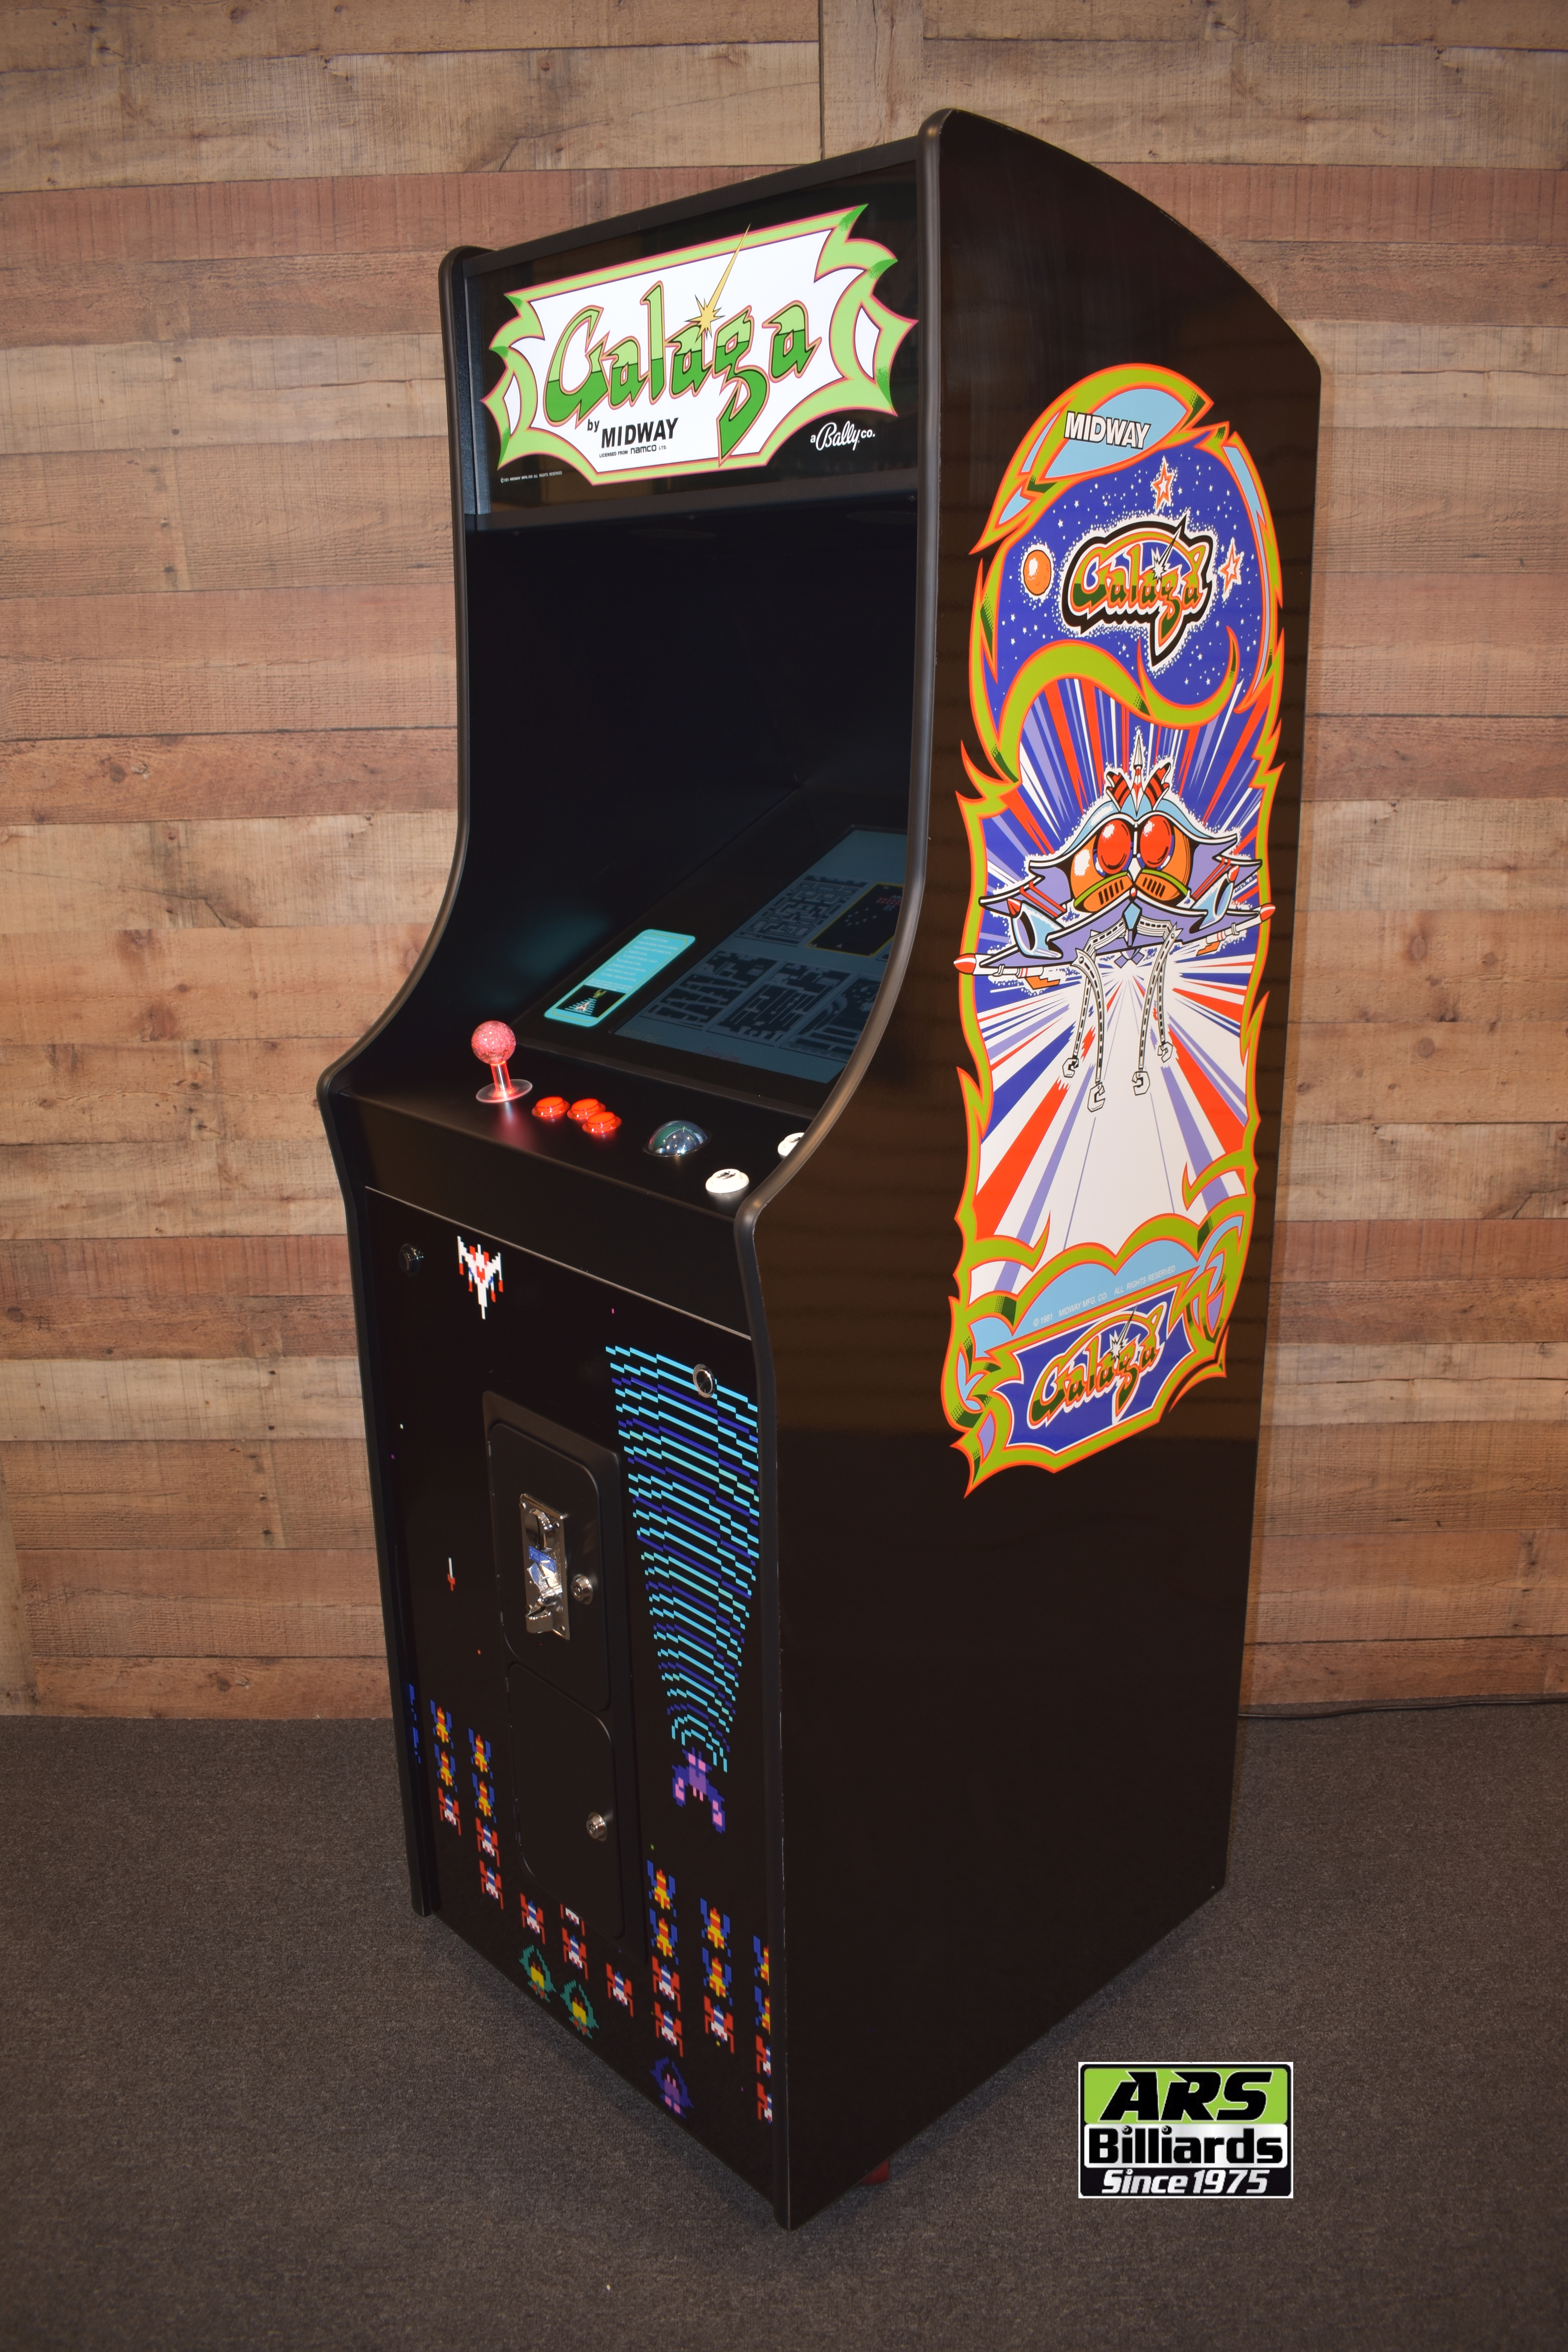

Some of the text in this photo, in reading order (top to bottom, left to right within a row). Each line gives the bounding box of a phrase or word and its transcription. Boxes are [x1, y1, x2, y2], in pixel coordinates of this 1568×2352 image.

[544, 280, 821, 467] Galaga
[587, 419, 600, 433] by
[601, 417, 679, 448] MIDWAY
[810, 421, 875, 451] a Bally co.
[1064, 410, 1151, 449] MIDWAY
[630, 445, 657, 454] namco
[1068, 534, 1206, 648] Galaga
[1040, 1313, 1053, 1324] 1981
[1059, 1302, 1082, 1317] MIDWAY
[1083, 1296, 1096, 1308] MFG.
[1098, 1292, 1108, 1301] CO.
[1127, 1277, 1147, 1290] RIGHTS
[1148, 1265, 1176, 1282] RESERVED
[1029, 1307, 1165, 1425] Galaga
